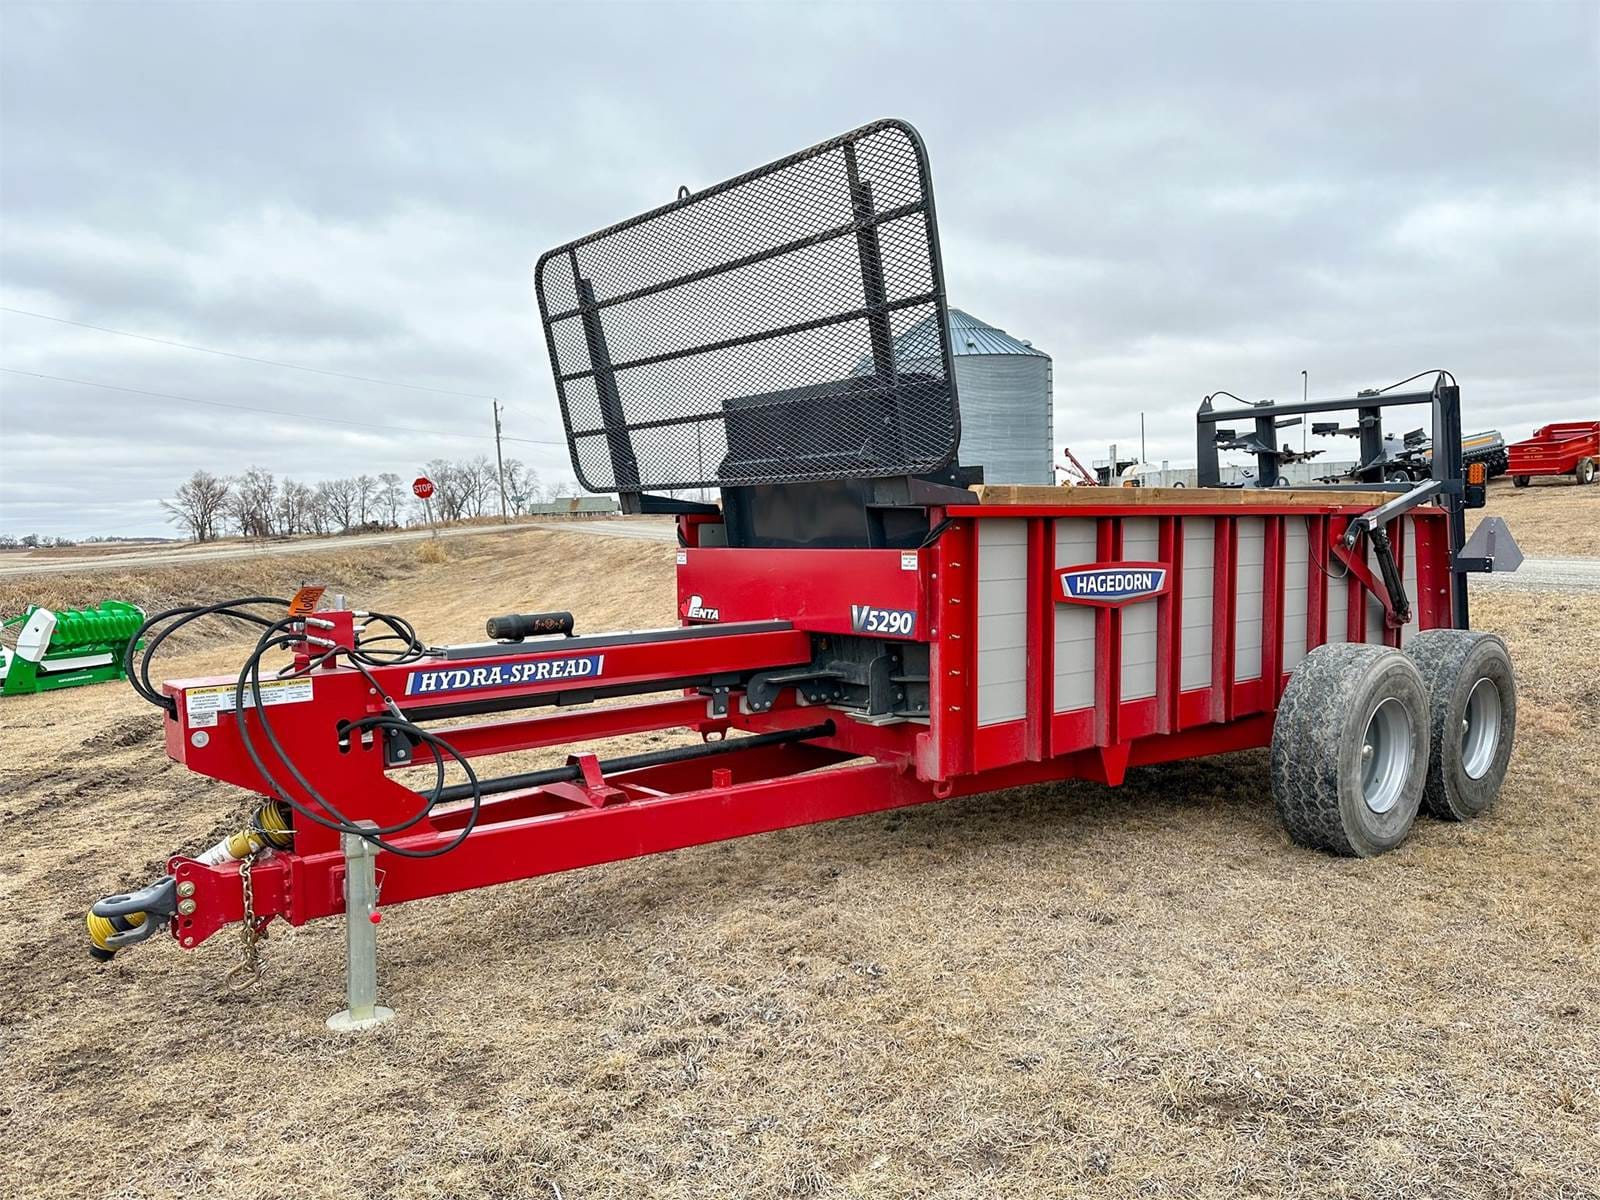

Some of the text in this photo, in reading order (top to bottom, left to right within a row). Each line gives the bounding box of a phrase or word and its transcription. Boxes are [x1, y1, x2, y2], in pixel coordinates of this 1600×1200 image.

[414, 483, 431, 494] STOP
[1076, 573, 1152, 594] HAGEDORN
[688, 595, 719, 620] PENTA
[851, 604, 912, 634] V5290
[419, 658, 592, 692] HYDRA-SPREAD
